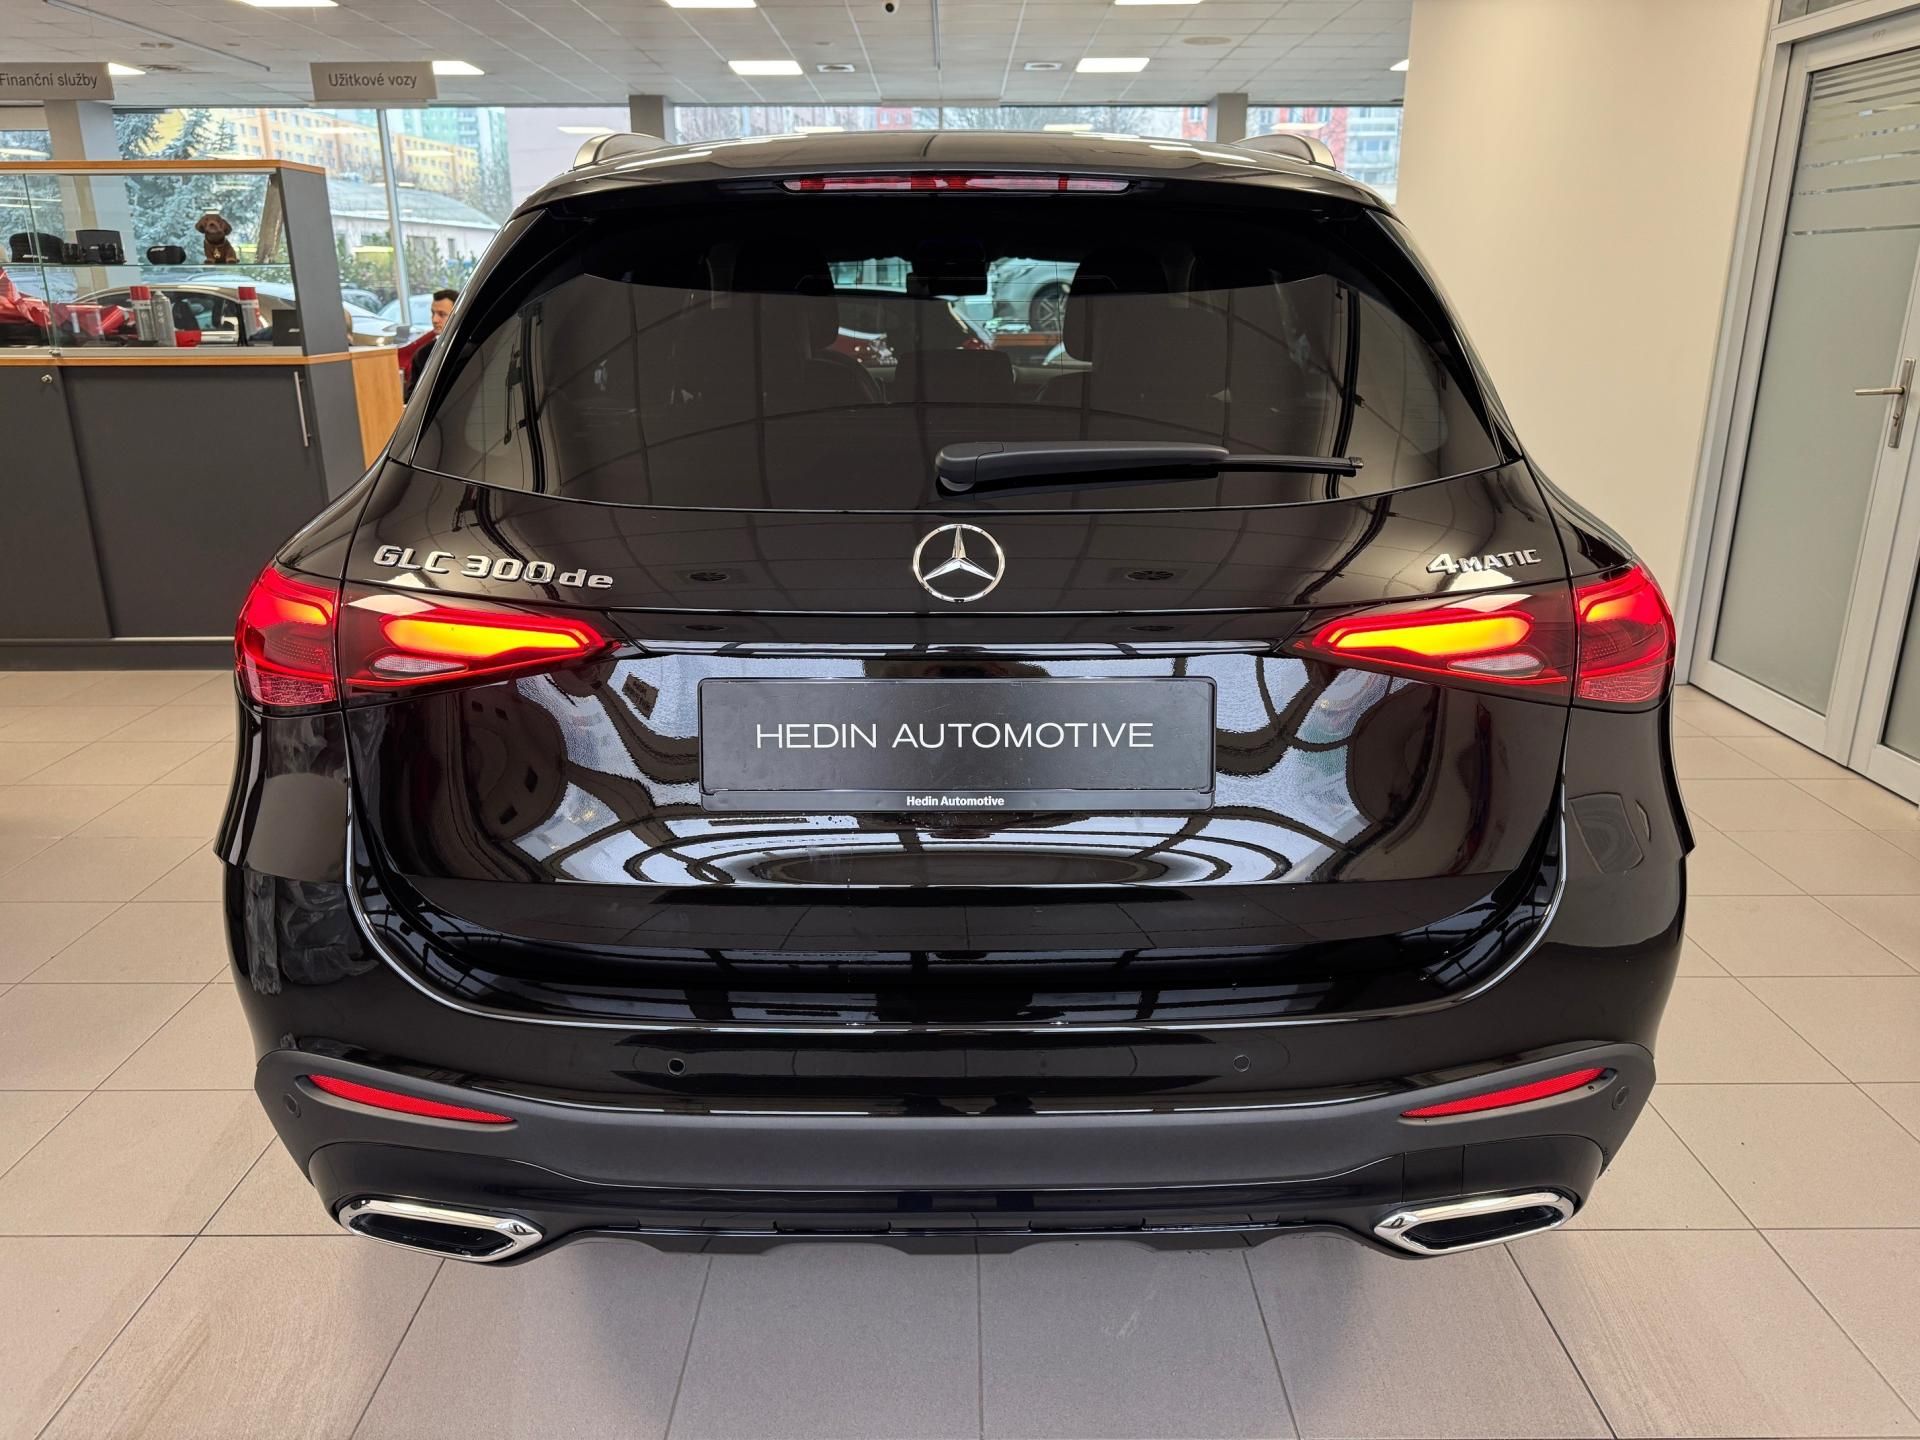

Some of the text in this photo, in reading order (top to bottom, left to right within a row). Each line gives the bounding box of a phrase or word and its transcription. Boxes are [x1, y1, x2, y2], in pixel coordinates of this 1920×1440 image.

[57, 72, 97, 89] služby
[328, 73, 417, 89] Užitkové vozy
[373, 545, 455, 574] GLC
[1425, 549, 1542, 575] 4MATIC
[756, 722, 1154, 748] HEDIN AUTOMOTIVE
[906, 796, 1005, 806] Hedin Automotive
